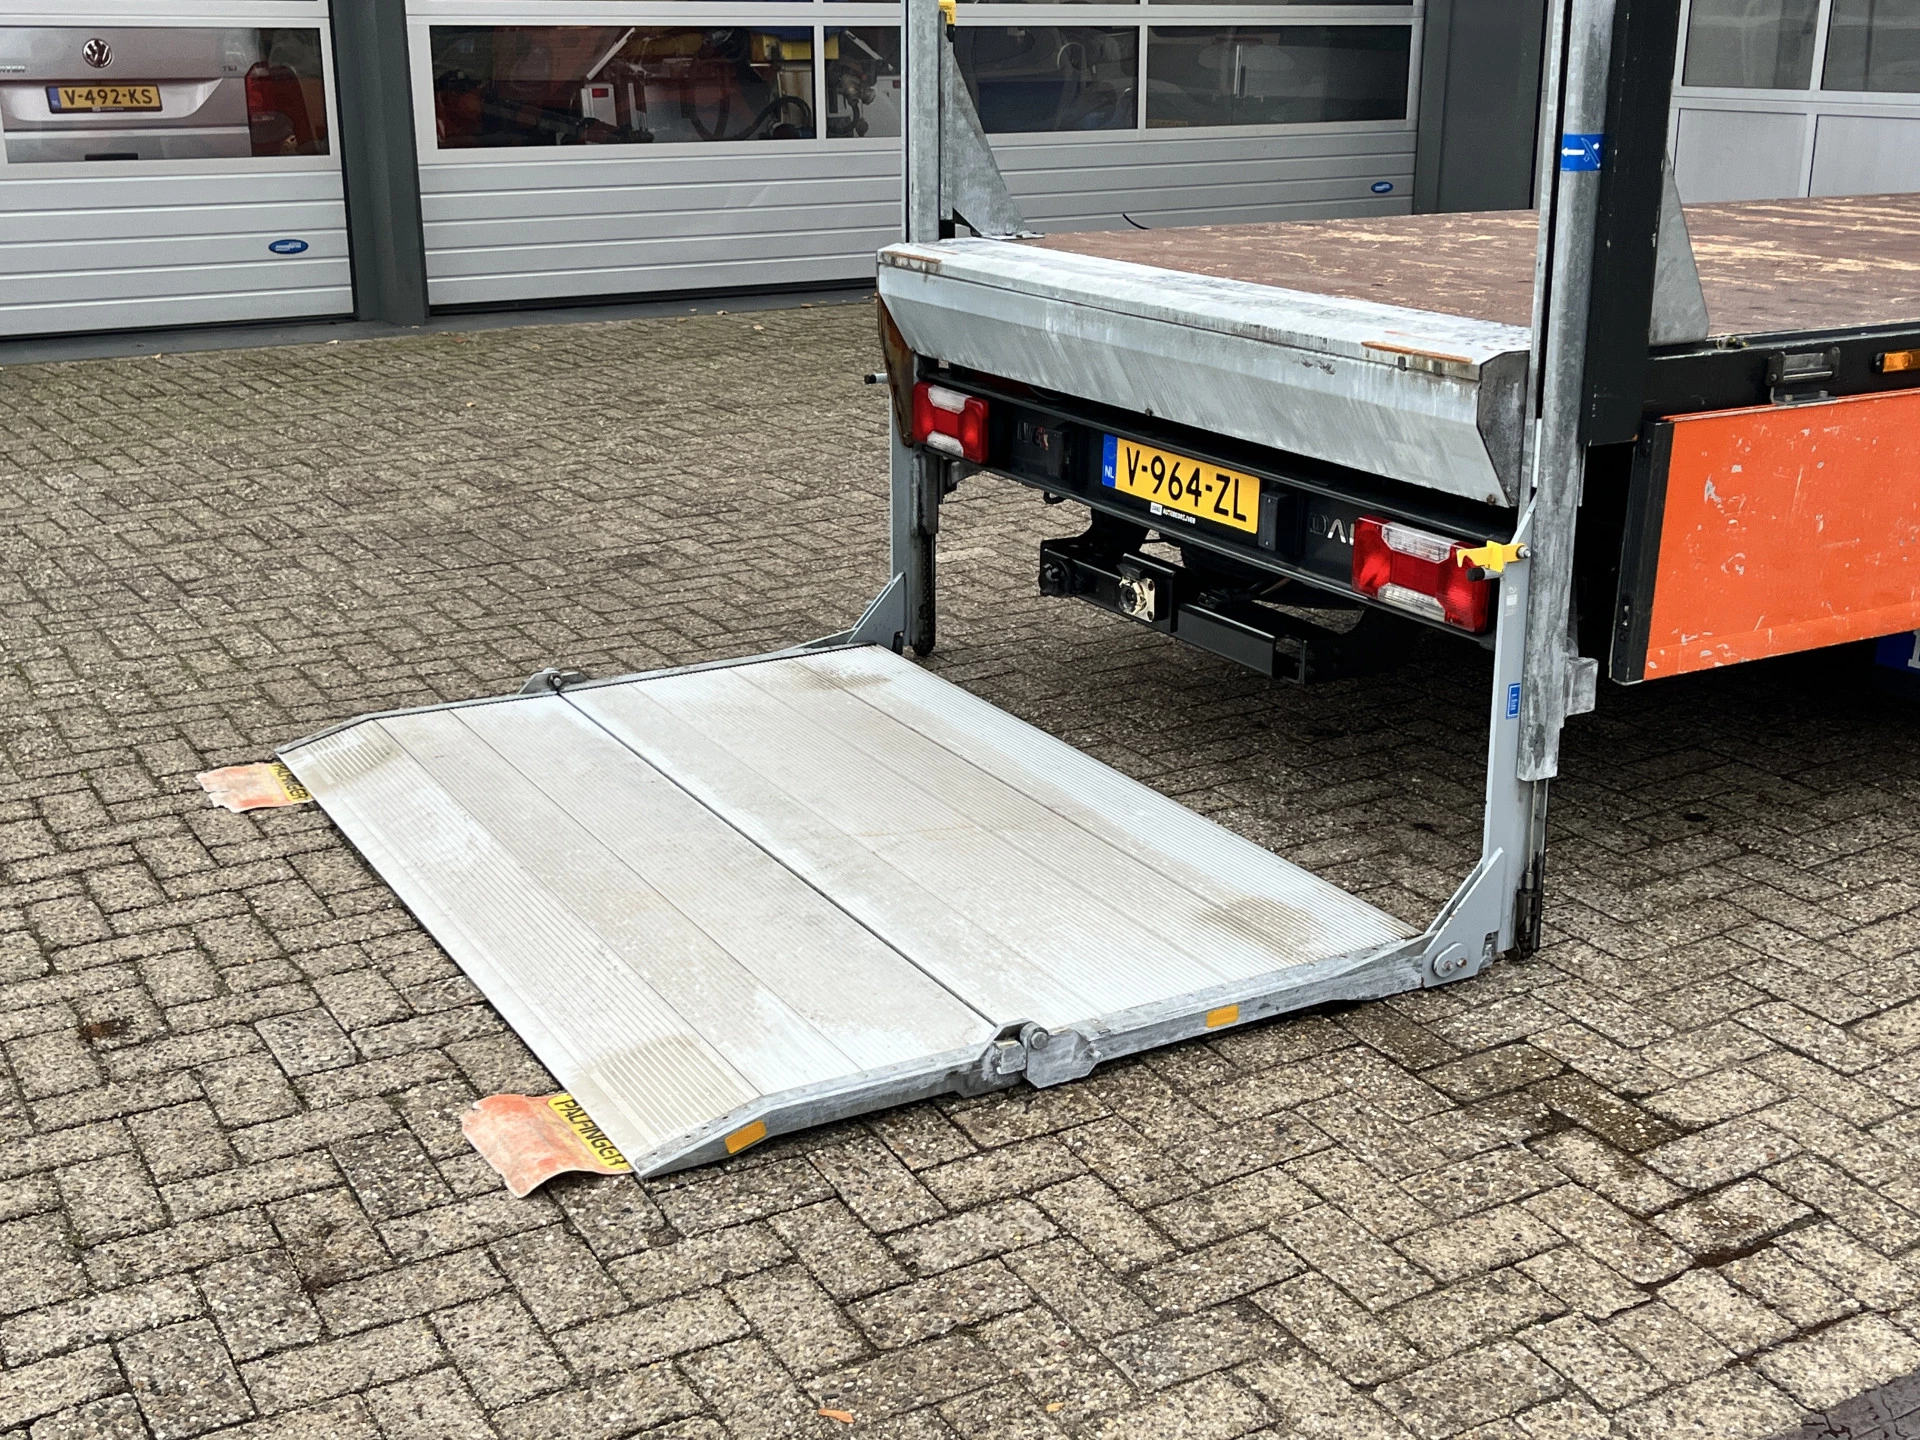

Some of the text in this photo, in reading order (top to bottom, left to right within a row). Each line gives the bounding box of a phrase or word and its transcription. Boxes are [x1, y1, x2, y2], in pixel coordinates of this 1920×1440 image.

[64, 88, 153, 106] V-492-KS
[1104, 446, 1247, 523] NL V-964-ZL
[554, 1098, 628, 1167] PALFINGER
